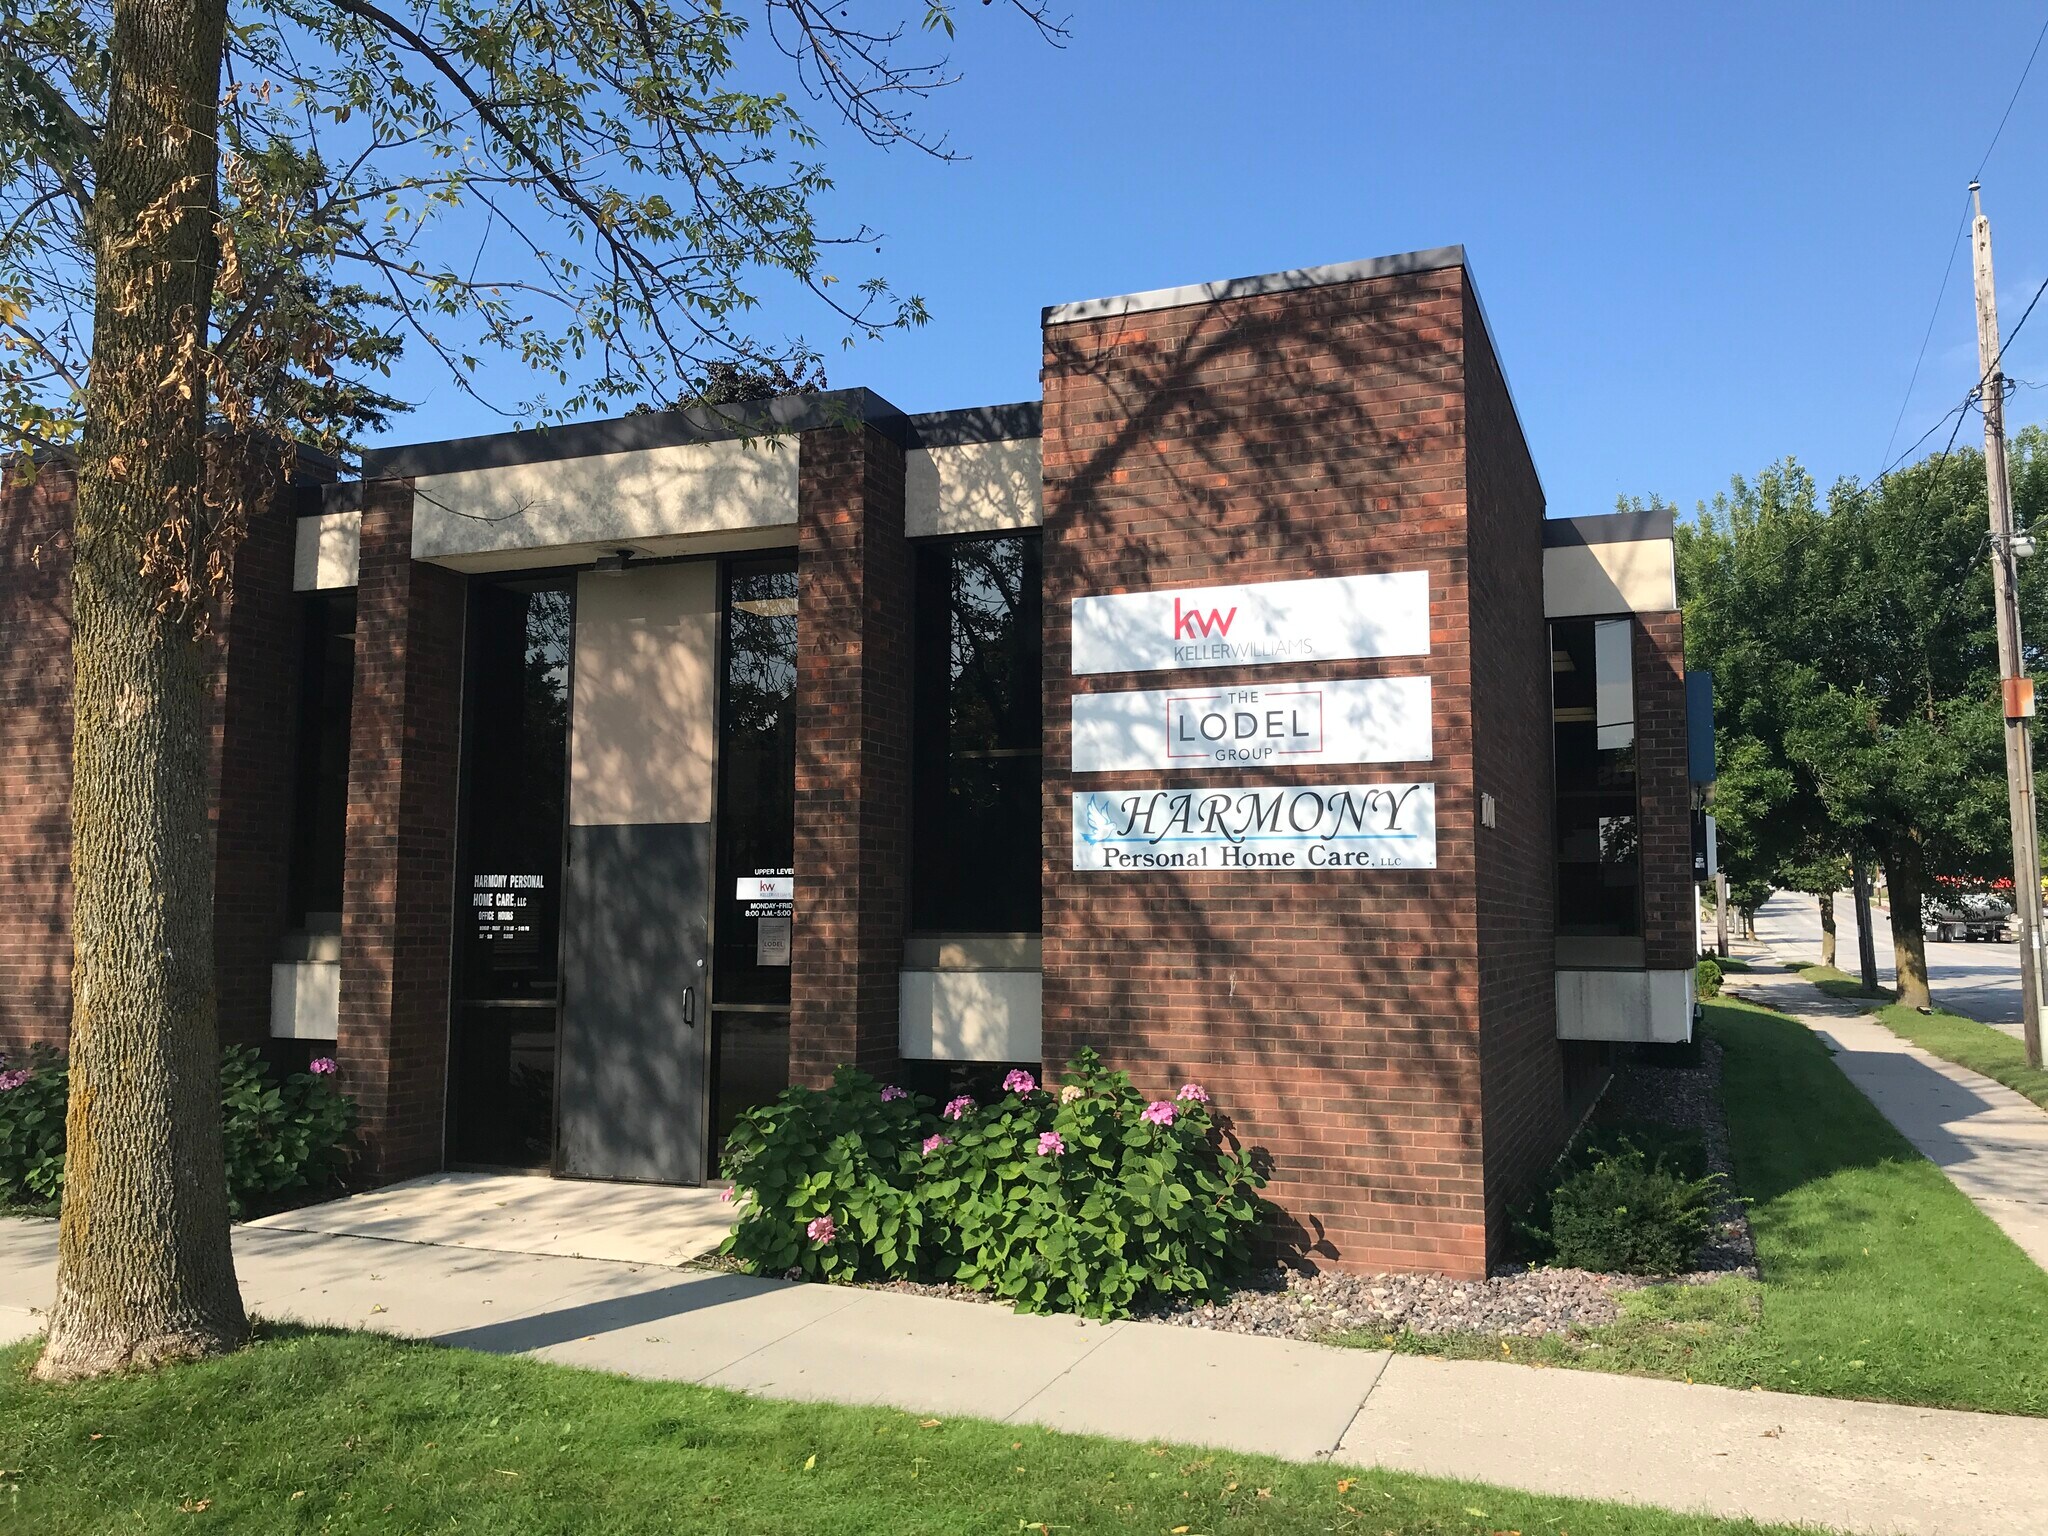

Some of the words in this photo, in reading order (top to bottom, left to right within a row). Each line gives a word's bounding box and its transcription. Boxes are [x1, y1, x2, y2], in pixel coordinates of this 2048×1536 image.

[1174, 597, 1237, 640] kw
[1228, 691, 1259, 704] THE
[1179, 710, 1309, 741] LODEL
[1215, 748, 1273, 761] GROUP
[1116, 784, 1420, 844] HARMONY
[1102, 847, 1208, 868] Personal
[1220, 846, 1295, 867] Home
[1380, 857, 1402, 866] LLC
[474, 874, 508, 888] HARMONY
[509, 874, 544, 888] PERSONAL
[759, 880, 775, 892] kw
[473, 893, 493, 907] HOME
[517, 897, 527, 907] LLC
